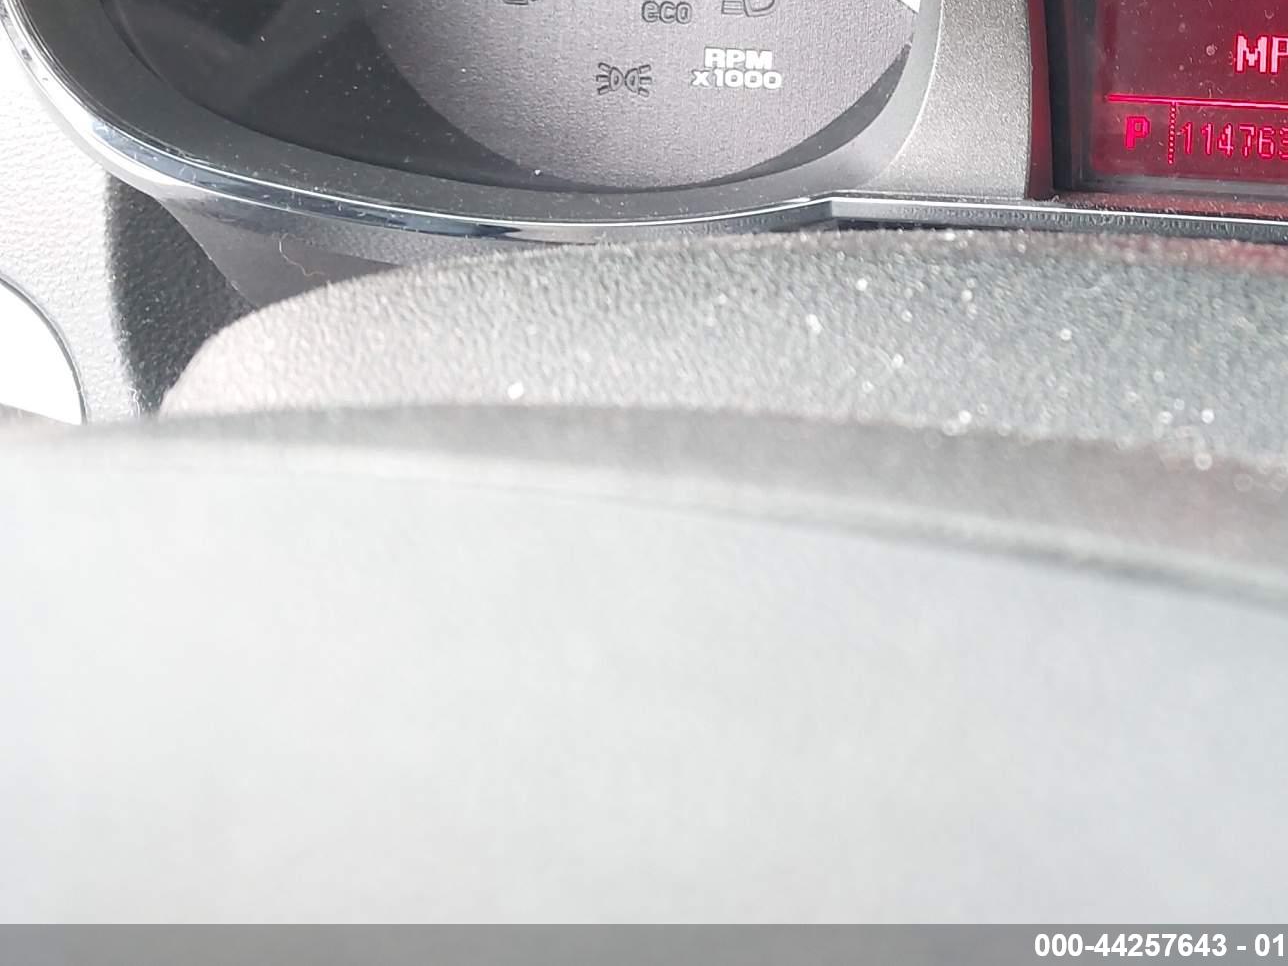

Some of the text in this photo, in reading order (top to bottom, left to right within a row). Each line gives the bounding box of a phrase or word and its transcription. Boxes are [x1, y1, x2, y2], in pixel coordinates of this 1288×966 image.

[641, 0, 692, 24] eco
[704, 48, 773, 69] RPM
[691, 70, 782, 90] x1000
[1124, 116, 1151, 149] P
